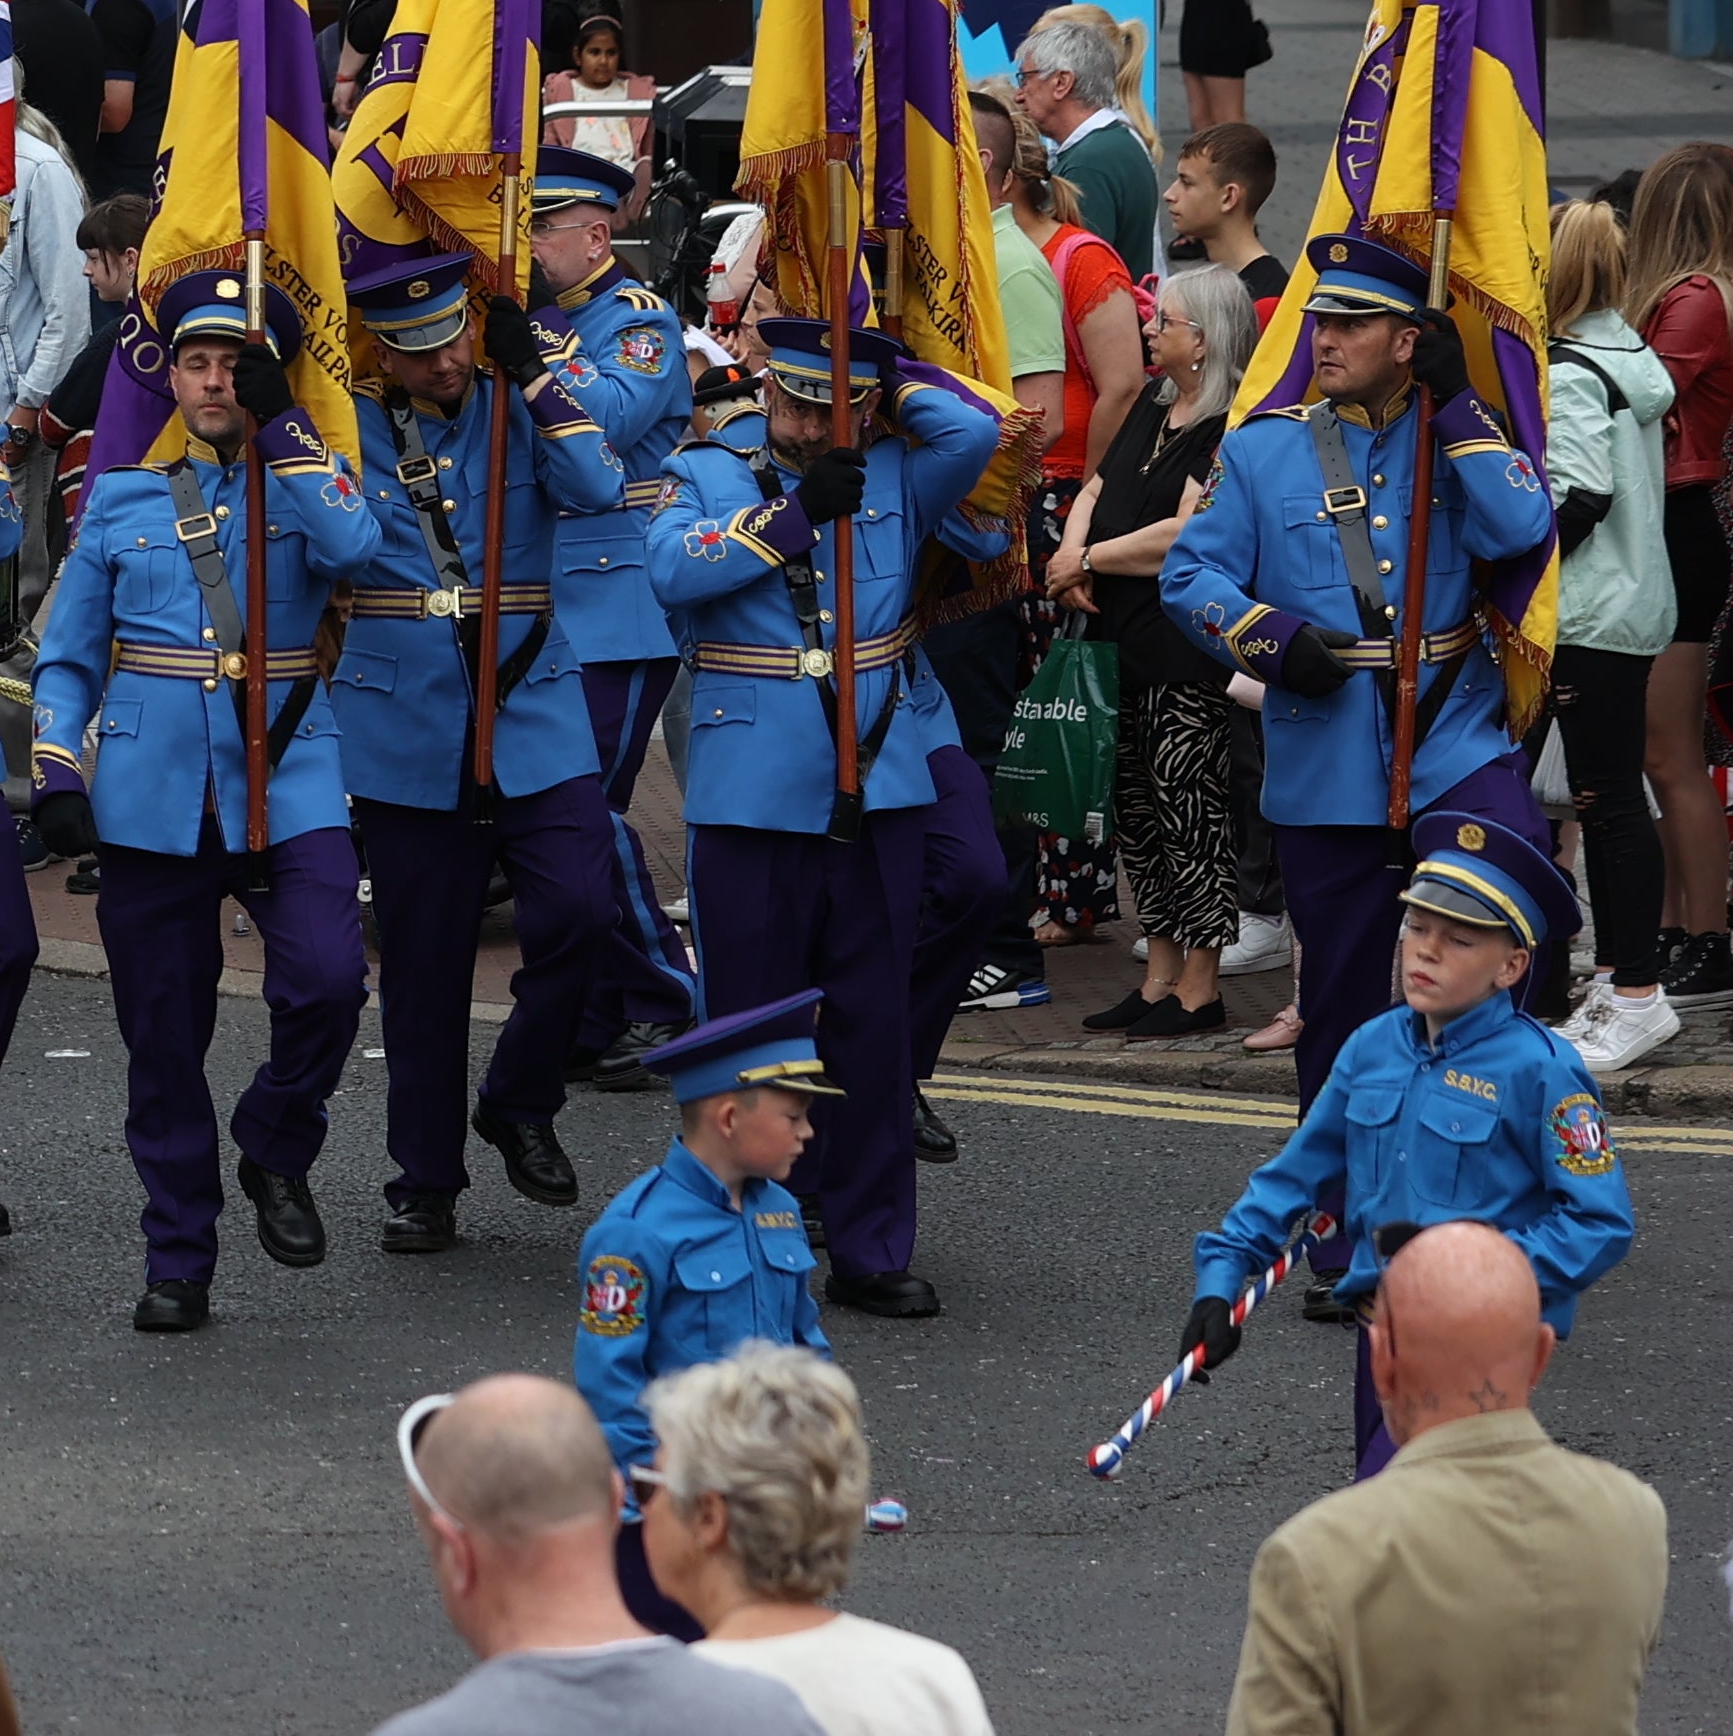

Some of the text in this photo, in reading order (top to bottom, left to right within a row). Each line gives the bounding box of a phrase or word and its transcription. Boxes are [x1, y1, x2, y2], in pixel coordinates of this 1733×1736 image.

[263, 245, 323, 318] LSTER
[903, 222, 948, 289] LSTER
[1002, 726, 1026, 753] yle
